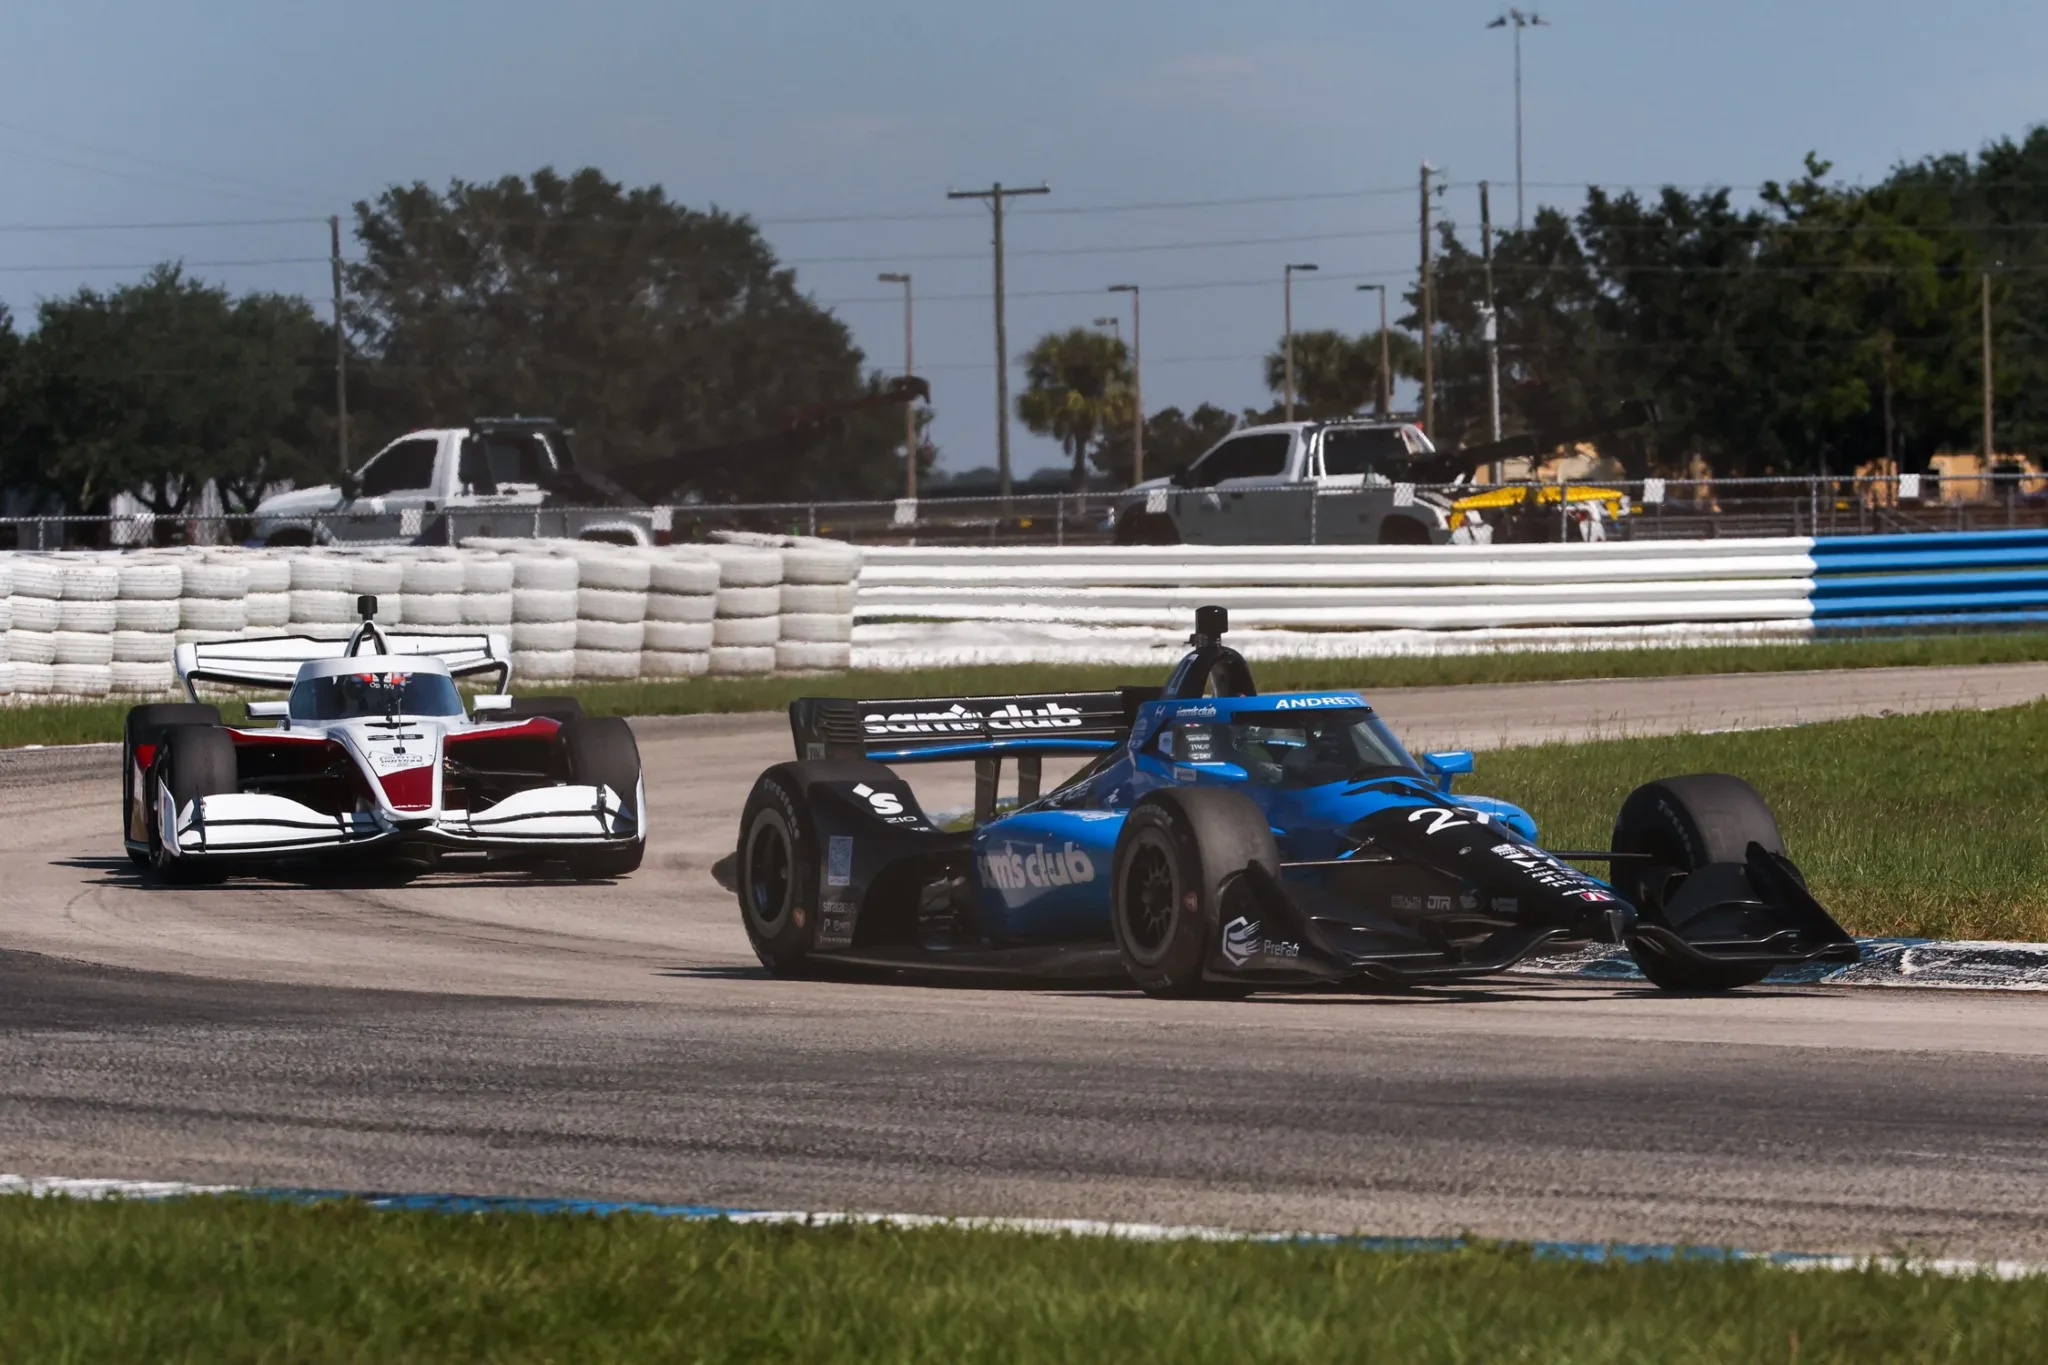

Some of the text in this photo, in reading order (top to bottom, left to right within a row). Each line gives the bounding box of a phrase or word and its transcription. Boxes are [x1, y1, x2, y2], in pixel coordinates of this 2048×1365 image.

[987, 703, 1083, 730] club
[1407, 807, 1490, 836] 27
[1025, 841, 1095, 888] club
[1263, 939, 1299, 958] PreFab
